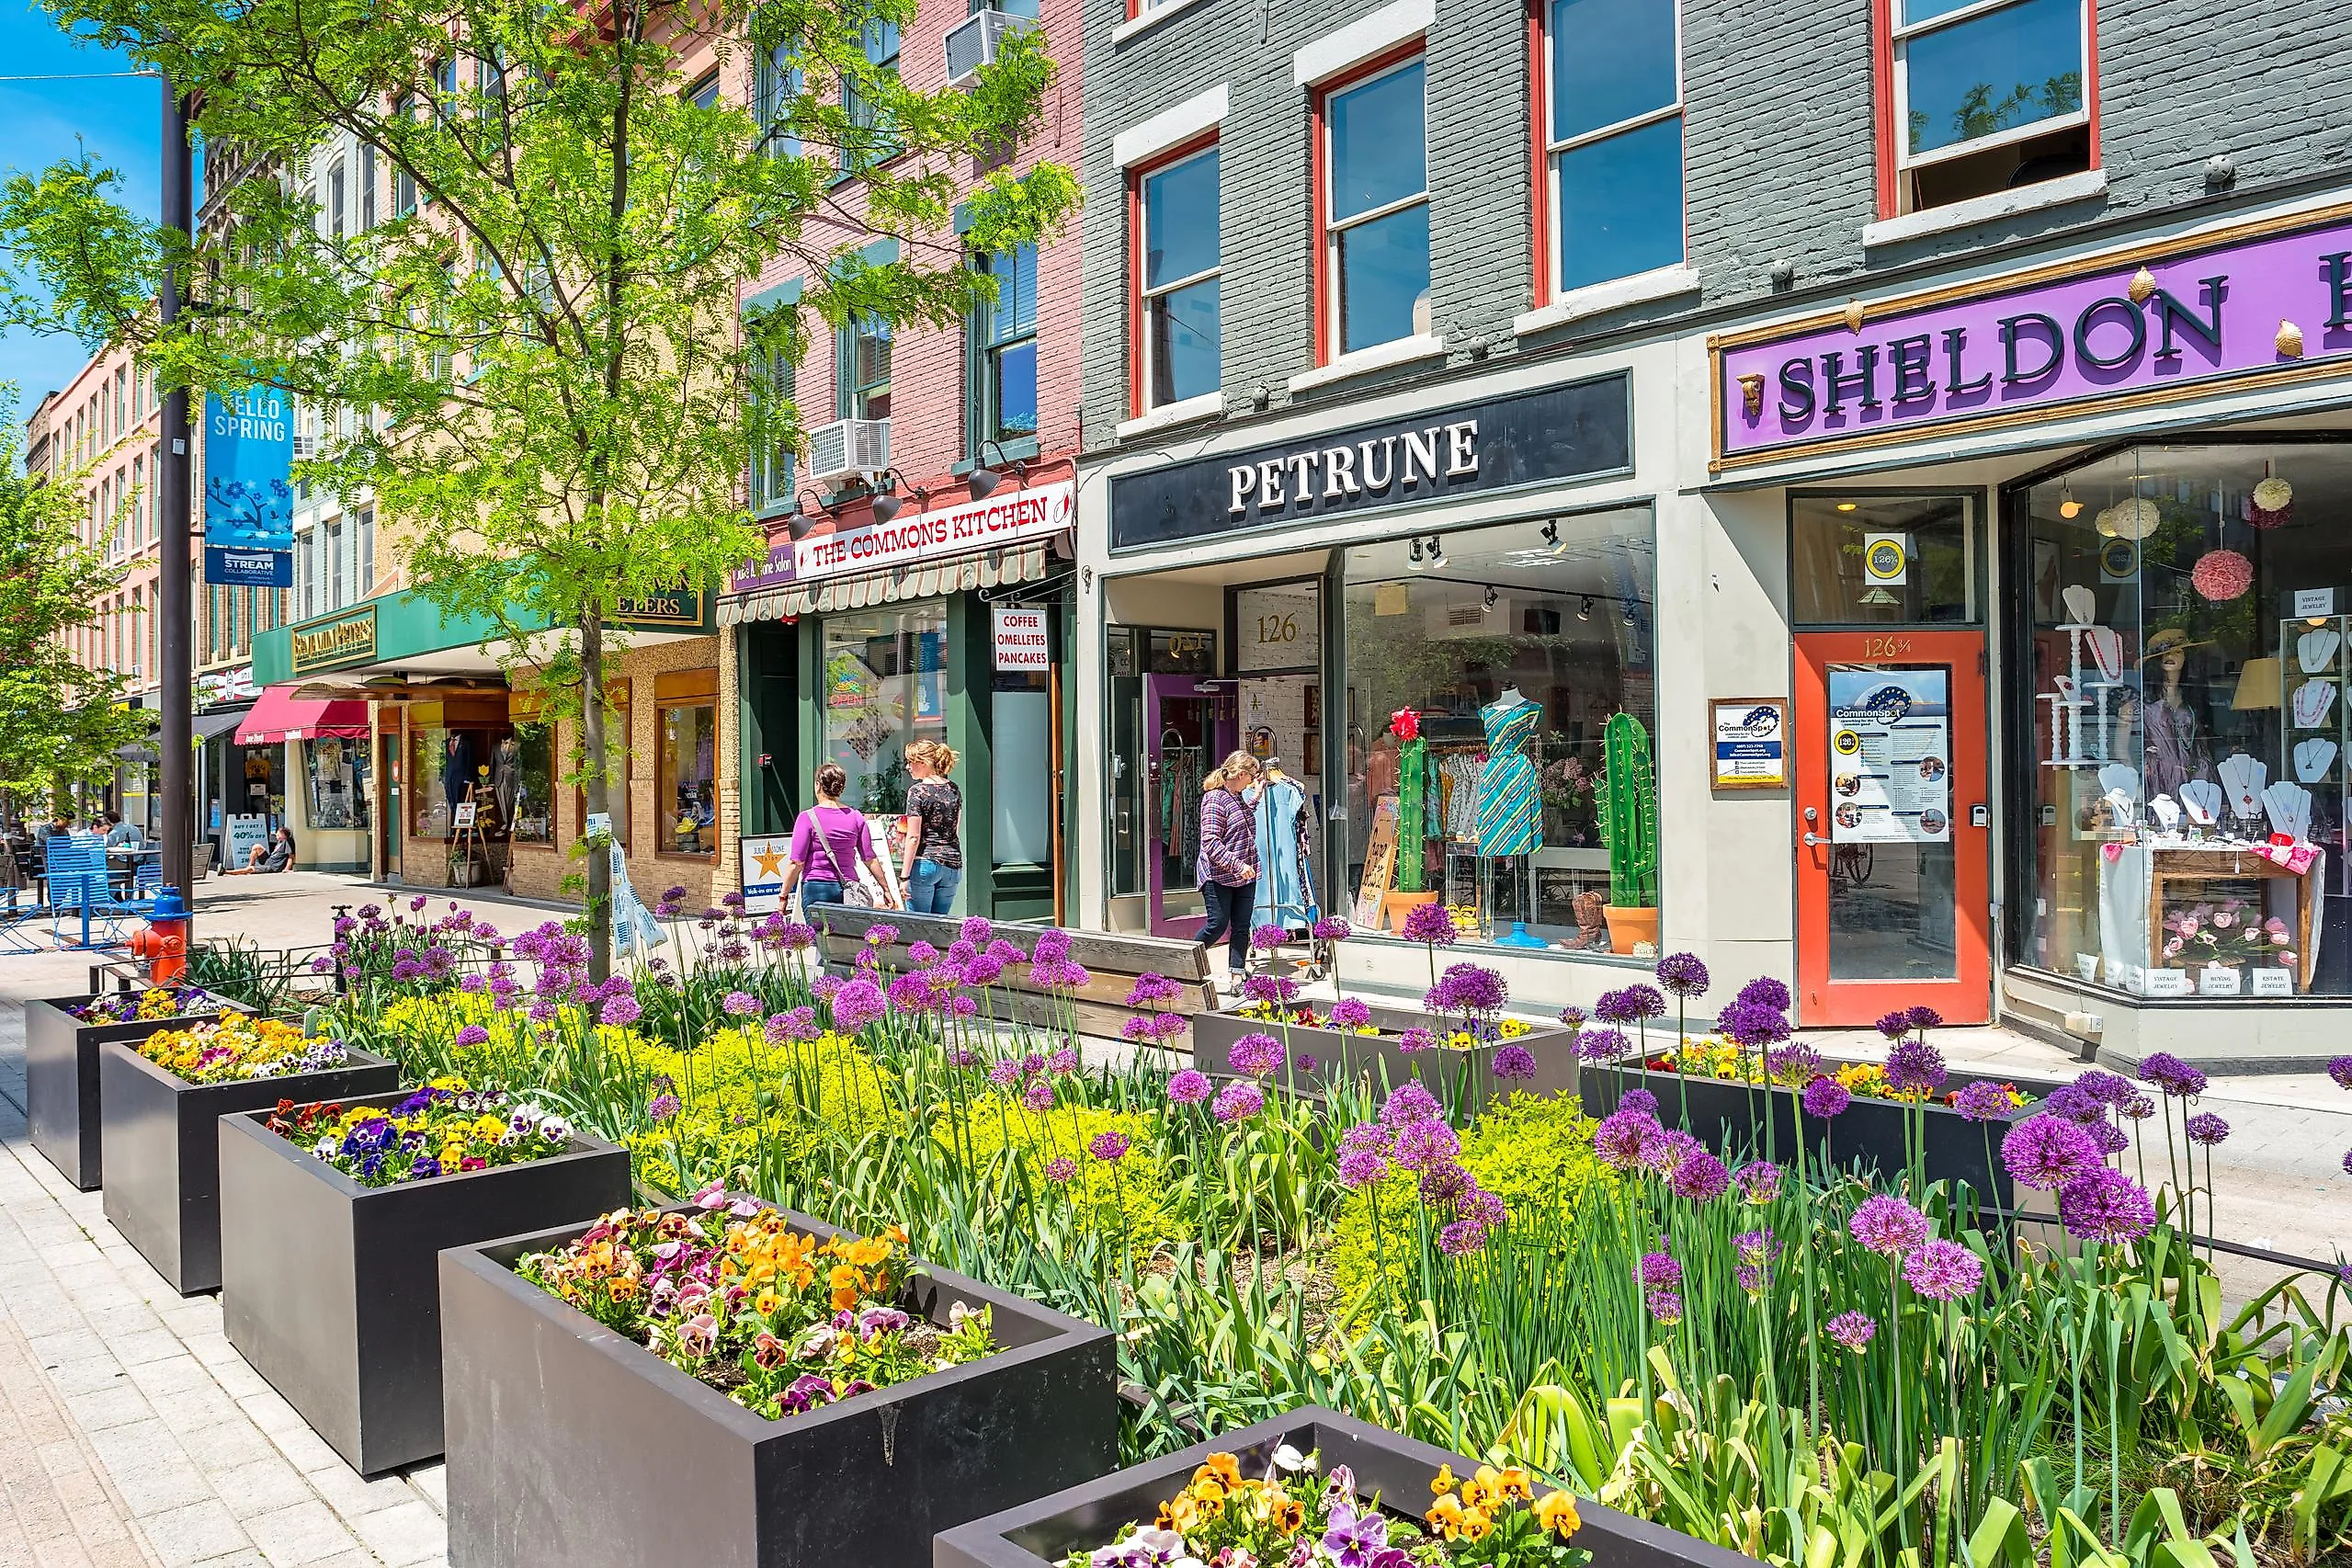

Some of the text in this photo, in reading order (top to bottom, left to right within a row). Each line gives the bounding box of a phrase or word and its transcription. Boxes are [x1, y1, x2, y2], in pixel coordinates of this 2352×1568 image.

[1778, 275, 2229, 420] SHELDON
[214, 415, 285, 442] SPRING
[1228, 420, 1479, 514] PETRUNE
[812, 496, 1048, 567] THE COMMONS KITCHEN
[224, 560, 274, 570] STREAM
[774, 552, 792, 573] Salon
[224, 568, 274, 576] COLLABORATIVE
[617, 596, 680, 615] ETERS
[1003, 615, 1039, 628] COFFEE
[1257, 612, 1297, 643] 126
[997, 634, 1046, 646] OMELLETES
[998, 652, 1047, 665] PANCAKES
[830, 694, 863, 706] OPEN
[1836, 709, 1900, 717] CommonSpot
